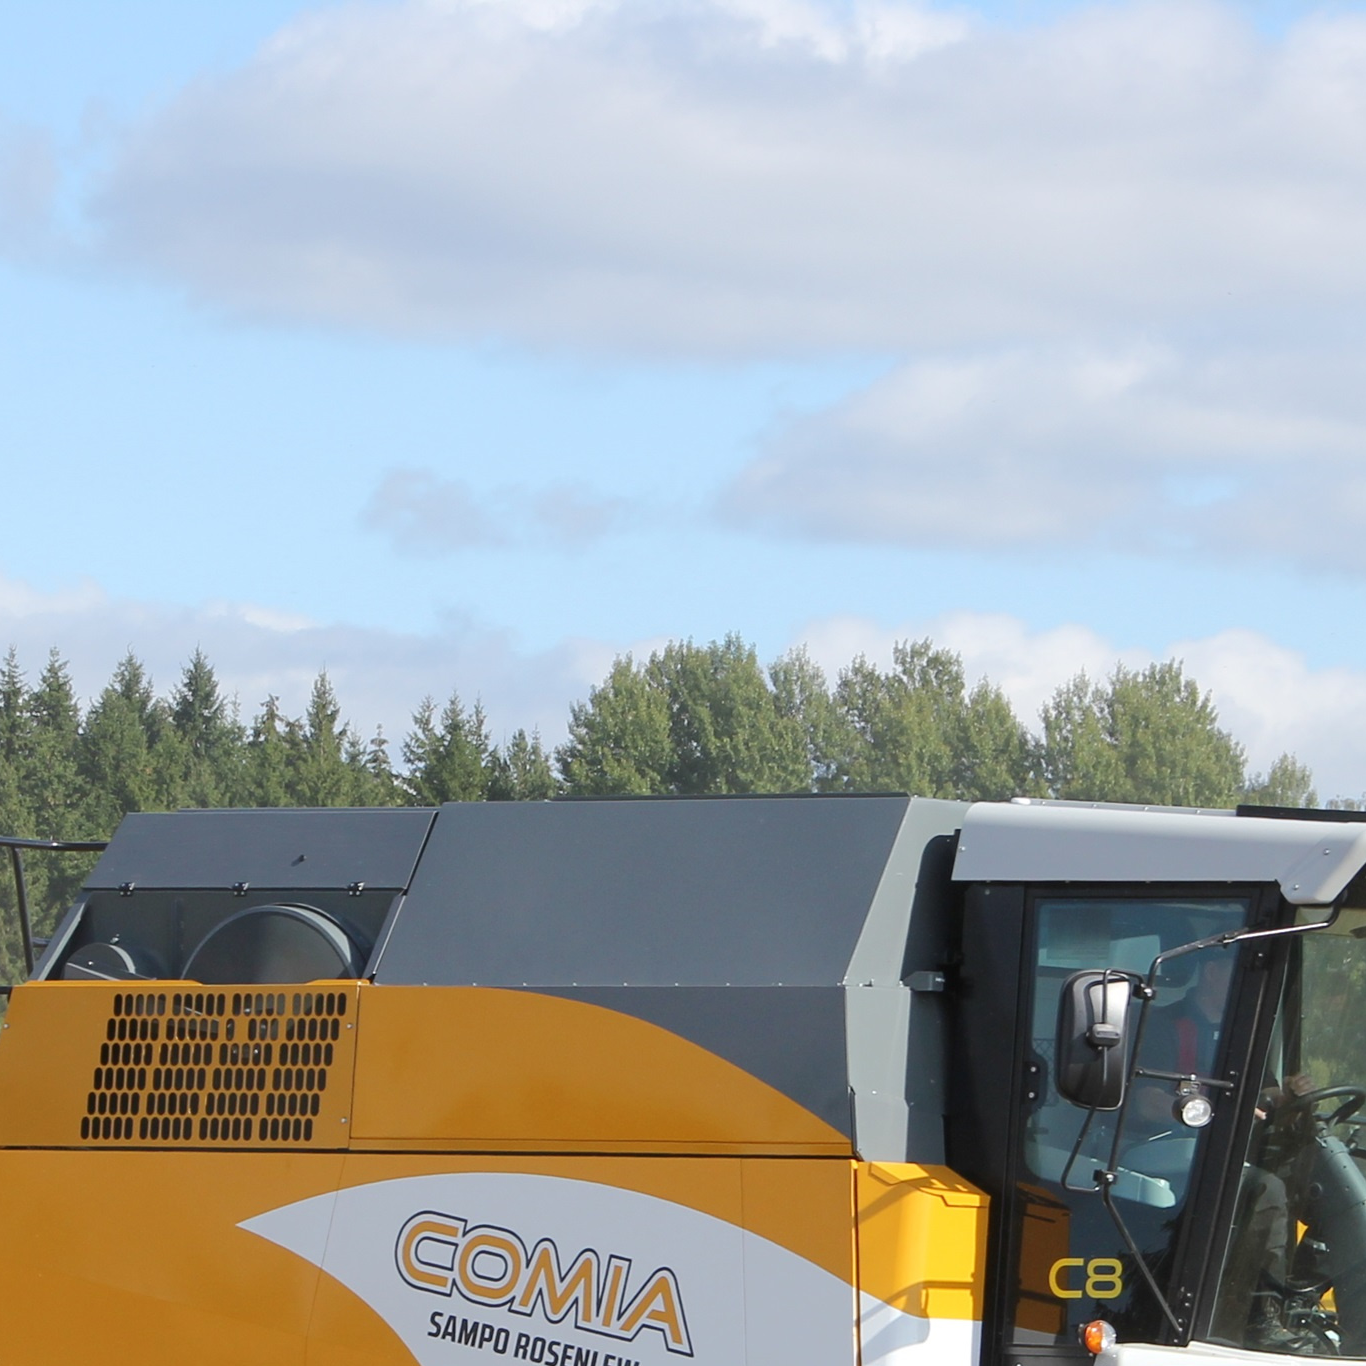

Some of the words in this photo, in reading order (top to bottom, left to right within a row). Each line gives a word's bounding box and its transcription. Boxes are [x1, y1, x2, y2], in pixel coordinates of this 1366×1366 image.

[394, 1209, 694, 1357] COMIA
[1048, 1257, 1124, 1299] C8
[427, 1310, 510, 1355] SAMPO
